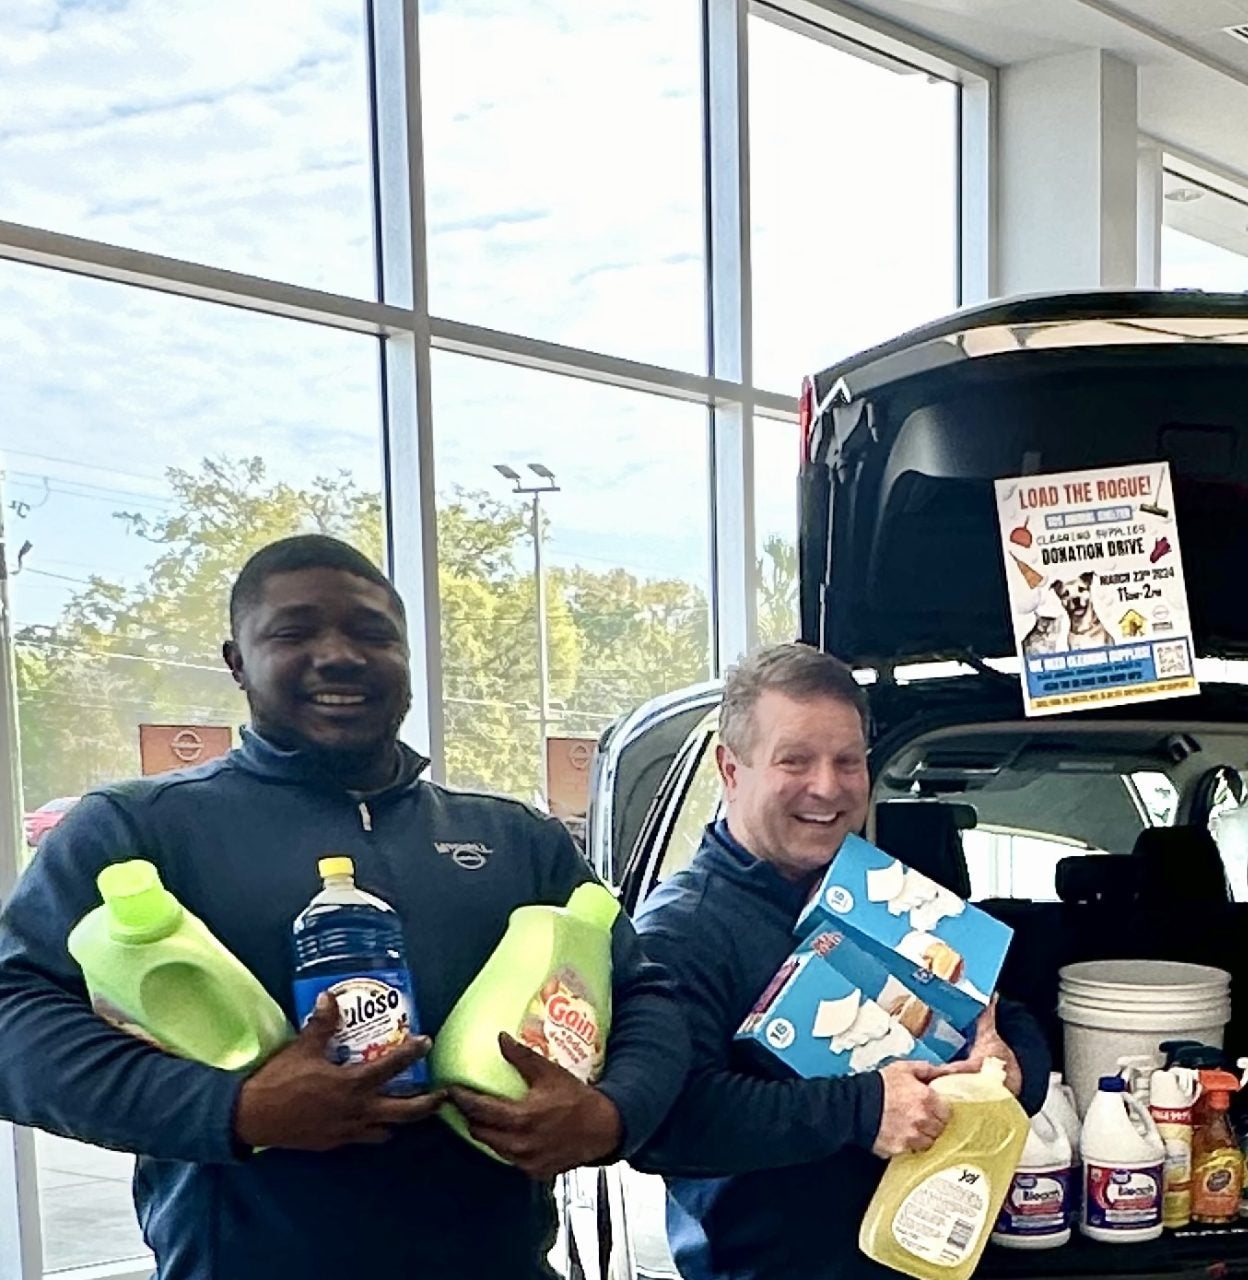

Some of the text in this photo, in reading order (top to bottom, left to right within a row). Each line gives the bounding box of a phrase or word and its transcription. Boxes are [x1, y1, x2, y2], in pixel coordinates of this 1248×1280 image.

[1018, 475, 1151, 510] LOAD THE ROGUE!
[1042, 537, 1145, 565] DONATION DRIVE
[1099, 571, 1130, 586] MARCH
[345, 990, 399, 1028] uloso
[548, 996, 595, 1041] Gain
